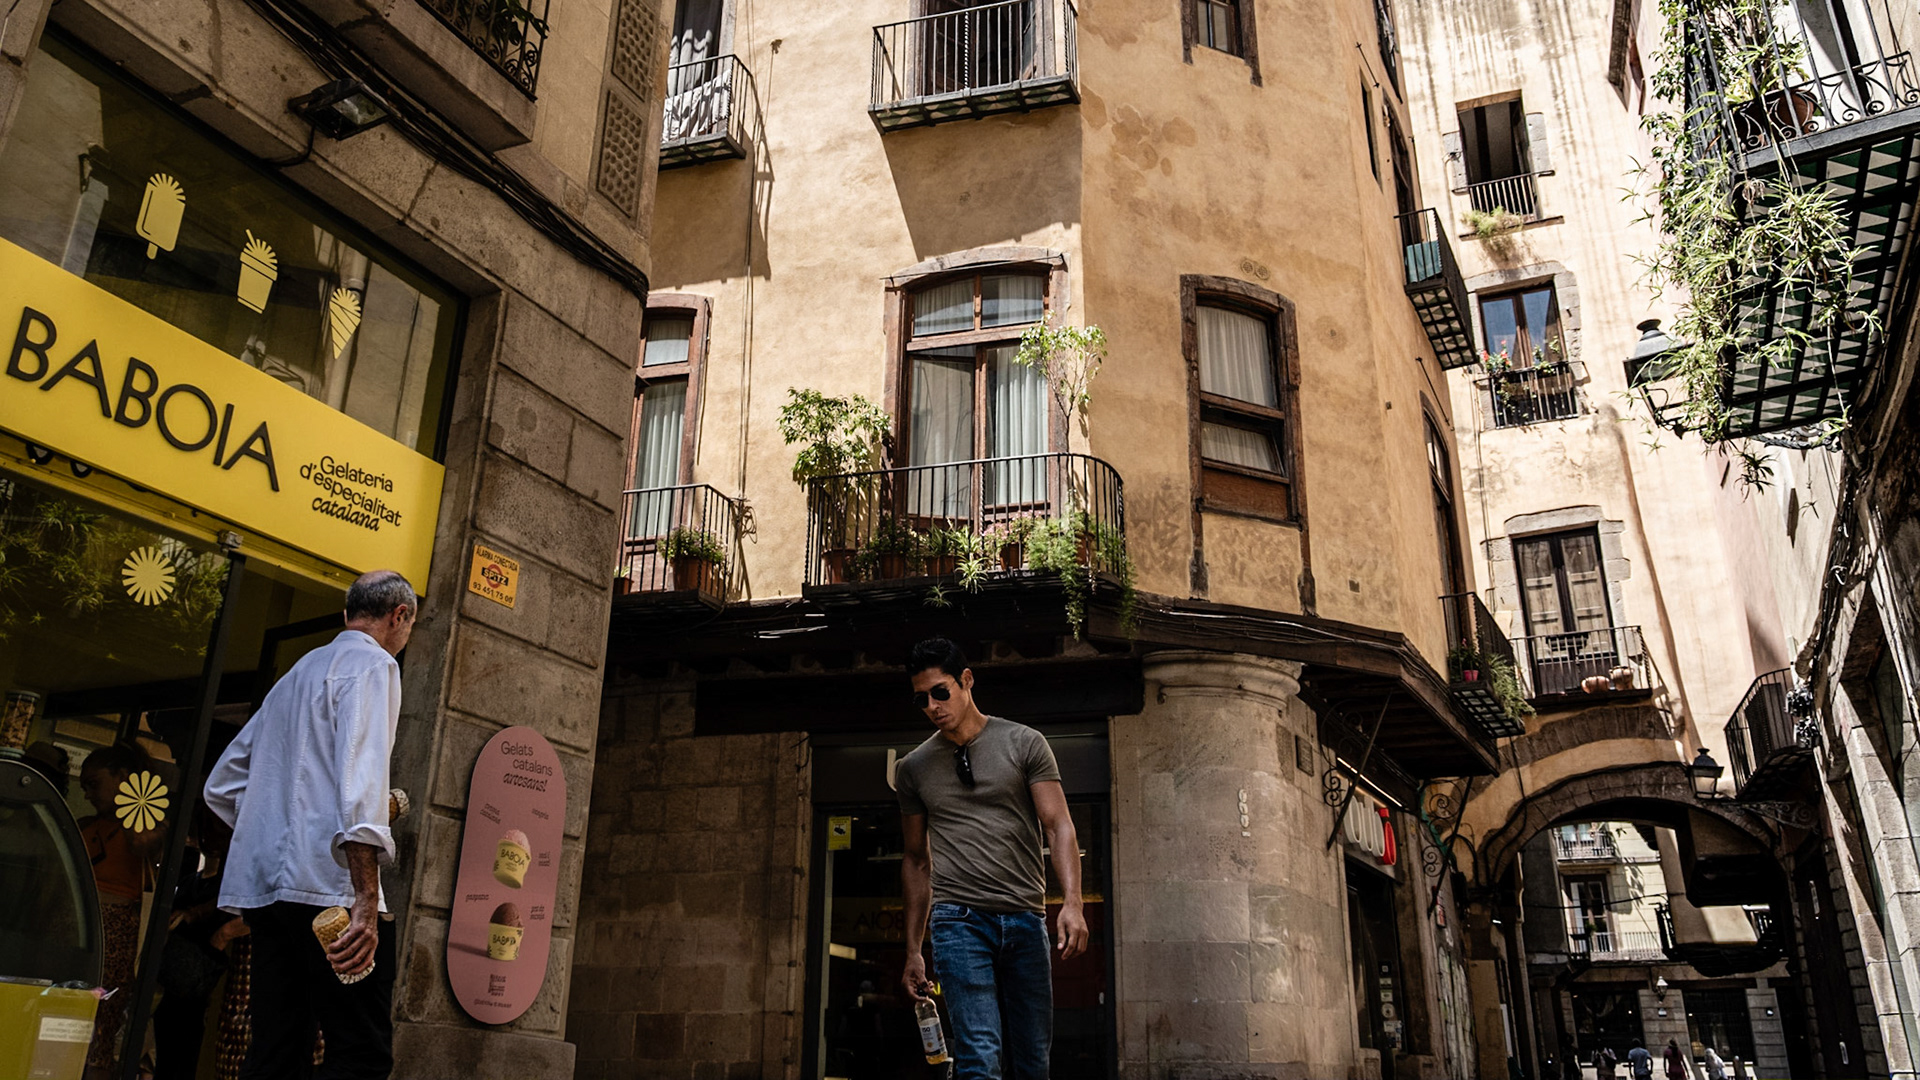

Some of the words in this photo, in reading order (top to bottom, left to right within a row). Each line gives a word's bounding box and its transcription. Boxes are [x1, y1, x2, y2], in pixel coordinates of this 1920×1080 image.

[7, 306, 279, 492] BABOIA
[320, 455, 393, 492] Gelateria
[300, 462, 402, 527] d'especialitat
[312, 497, 380, 532] catalana
[476, 547, 493, 560] ALARMA
[473, 581, 481, 591] 93
[496, 590, 504, 600] 75
[501, 740, 534, 757] Gelats
[512, 758, 553, 777] catalans
[503, 772, 548, 793] artesans!
